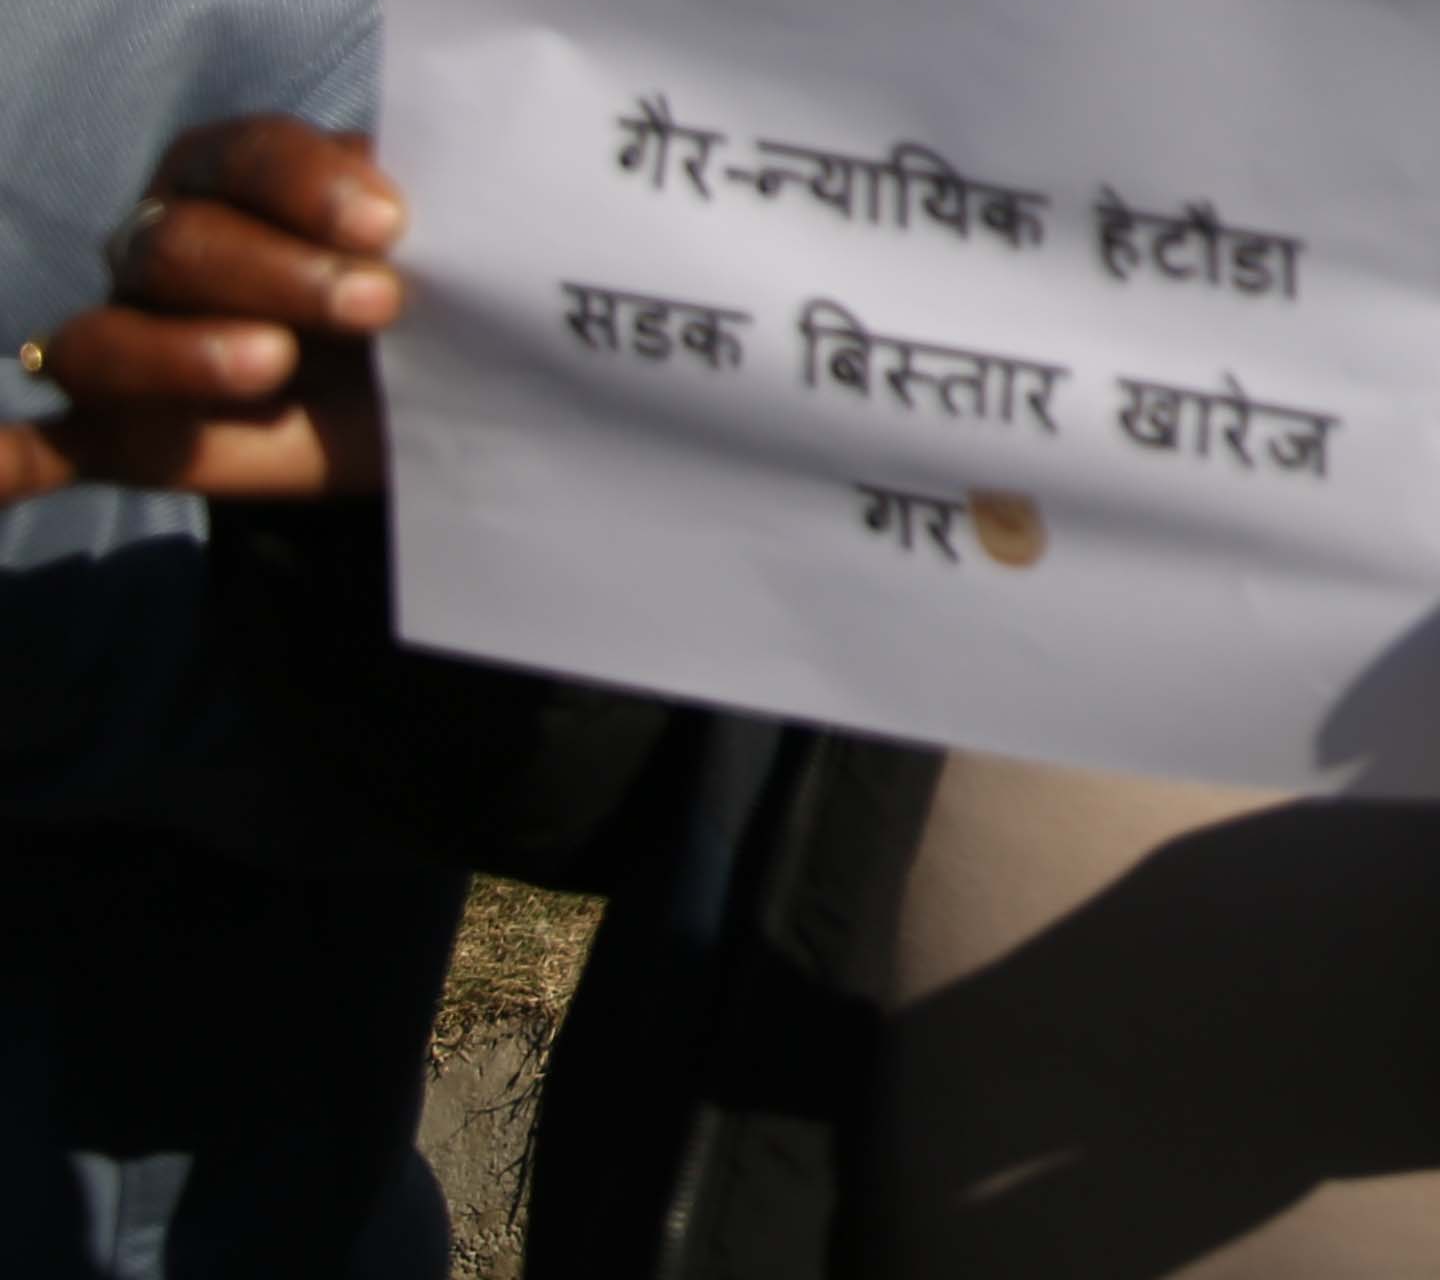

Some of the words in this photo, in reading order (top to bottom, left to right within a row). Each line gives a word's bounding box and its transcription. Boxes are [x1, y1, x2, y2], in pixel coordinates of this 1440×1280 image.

[615, 92, 1050, 251] गैर-न्यायिक
[1091, 182, 1305, 302] हेटौडा
[561, 280, 752, 370] सडक
[798, 297, 1071, 434] बिस्तार
[1116, 370, 1341, 480] खारेज
[855, 480, 967, 564] गर
